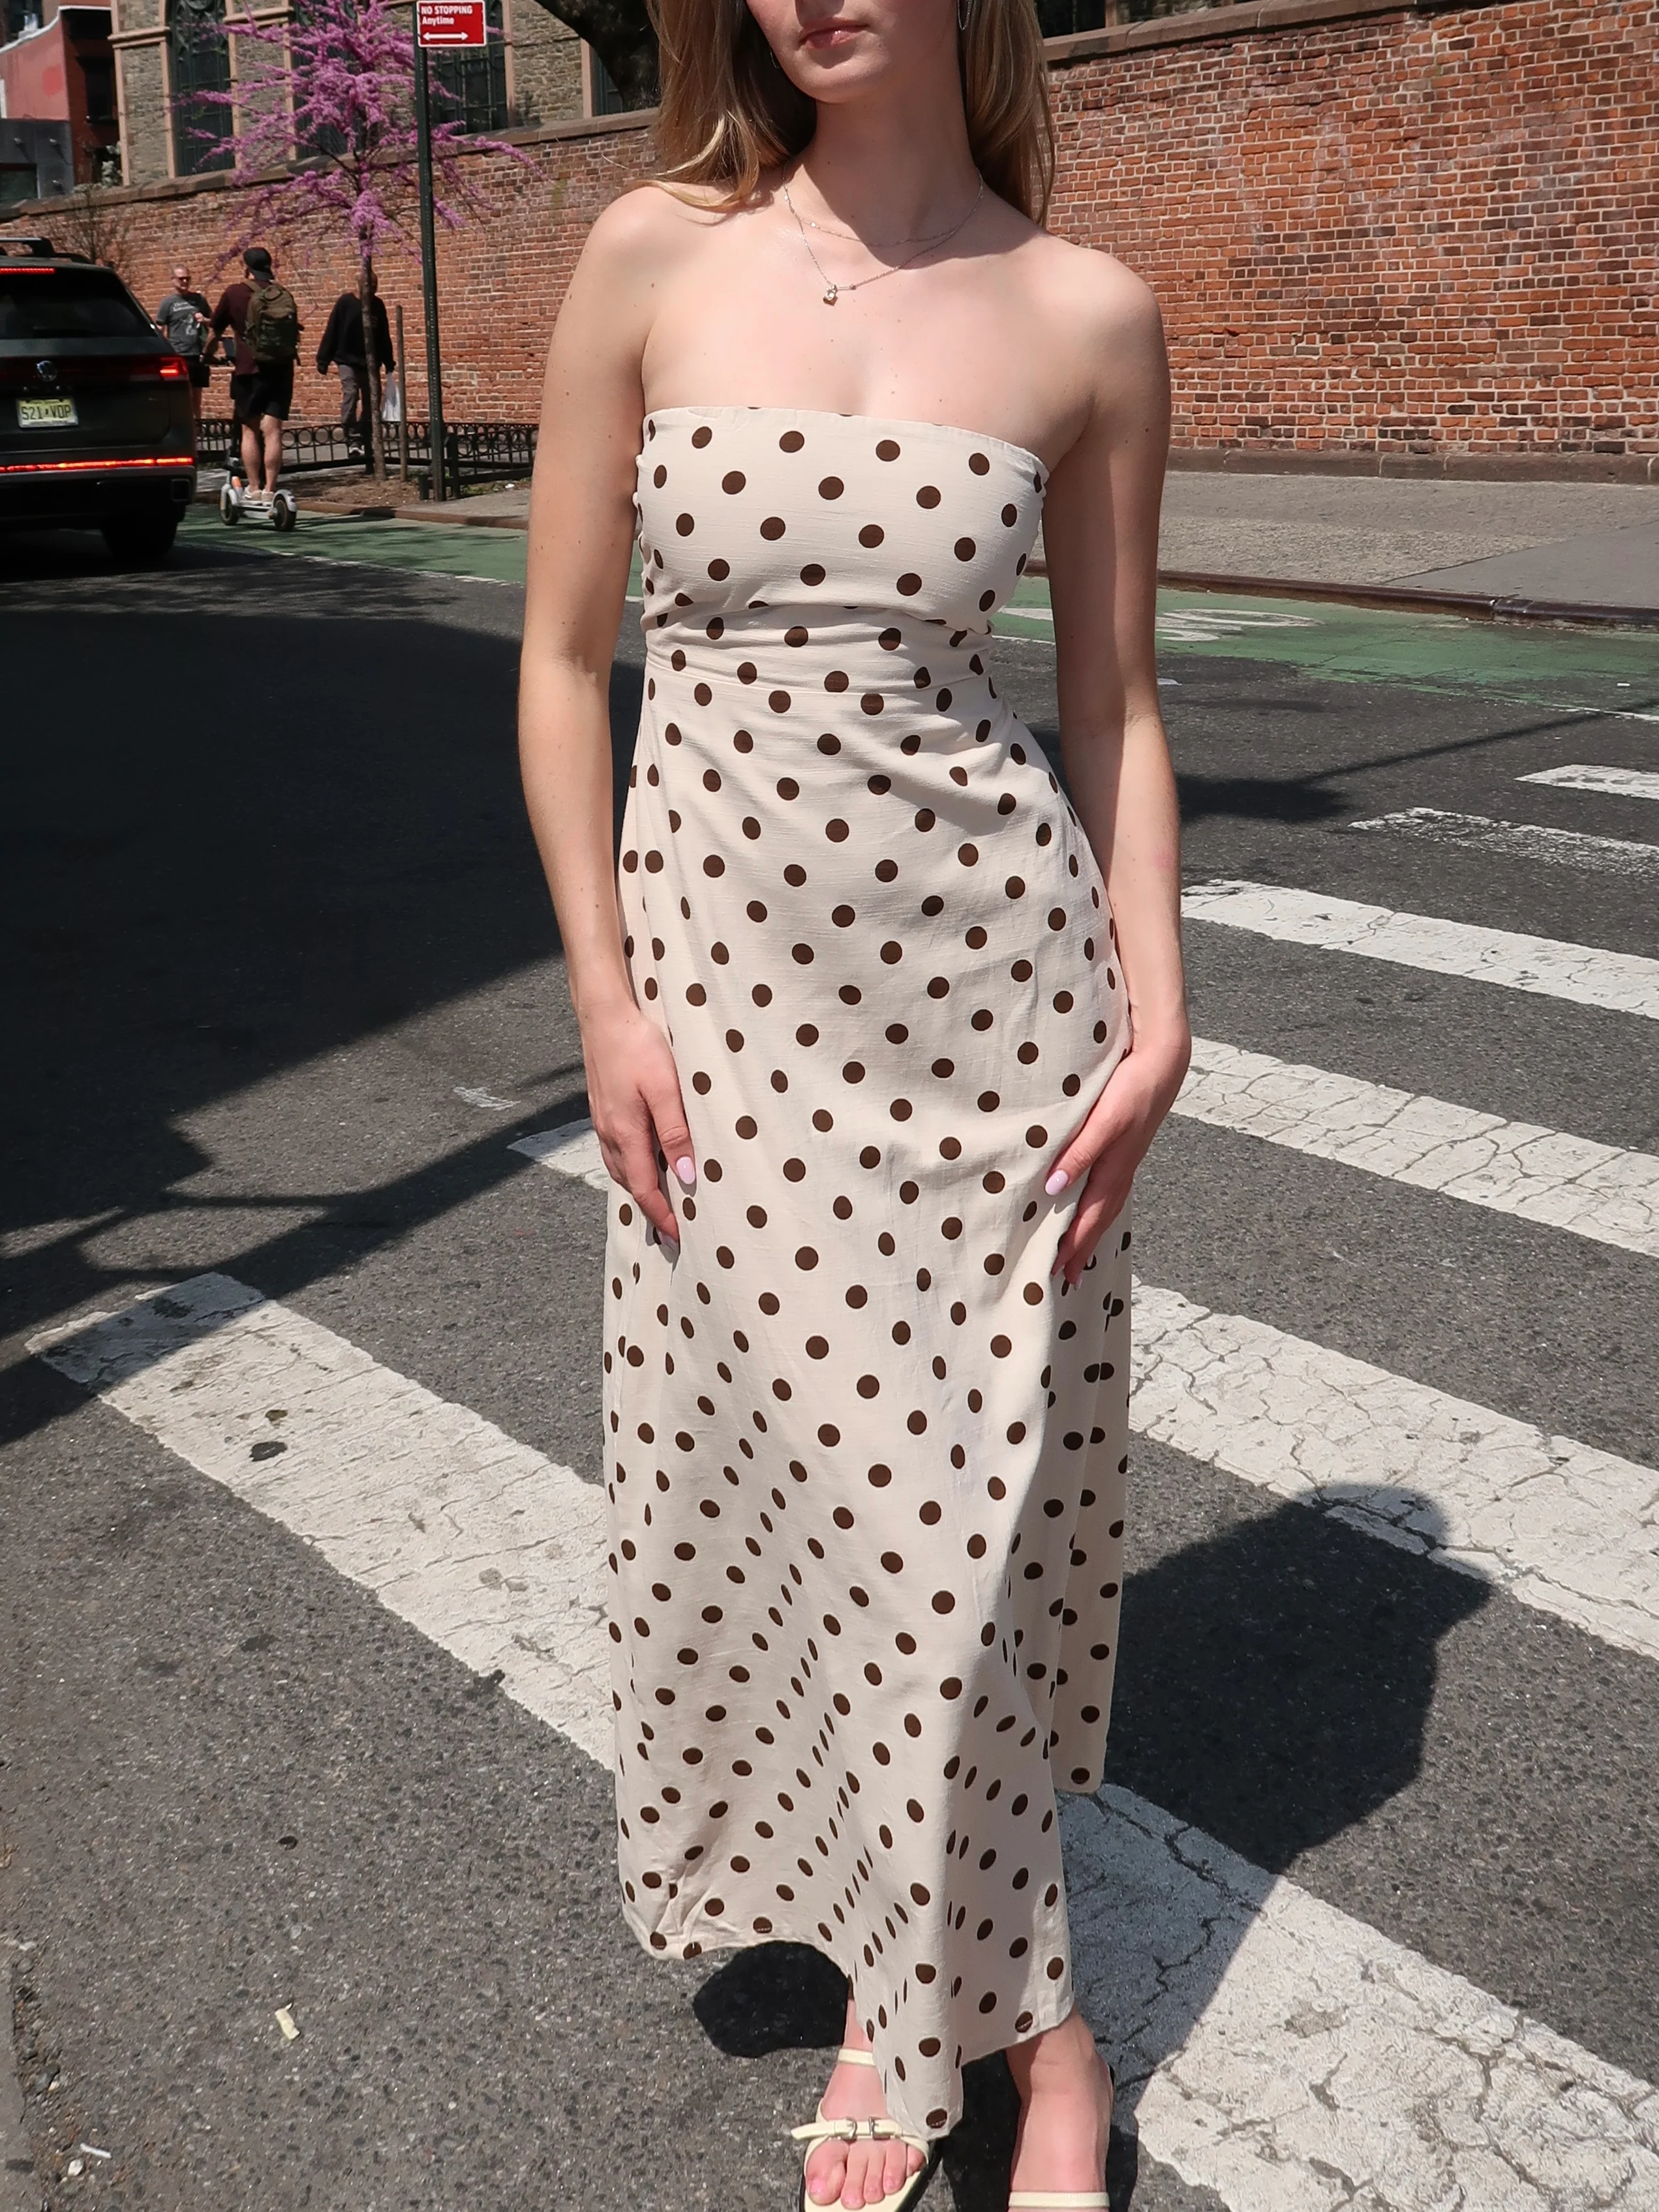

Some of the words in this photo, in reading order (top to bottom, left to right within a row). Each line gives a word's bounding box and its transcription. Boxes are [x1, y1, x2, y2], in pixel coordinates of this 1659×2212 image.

[421, 6, 433, 14] NO
[434, 5, 472, 14] STOPPING
[422, 16, 454, 26] Anytime
